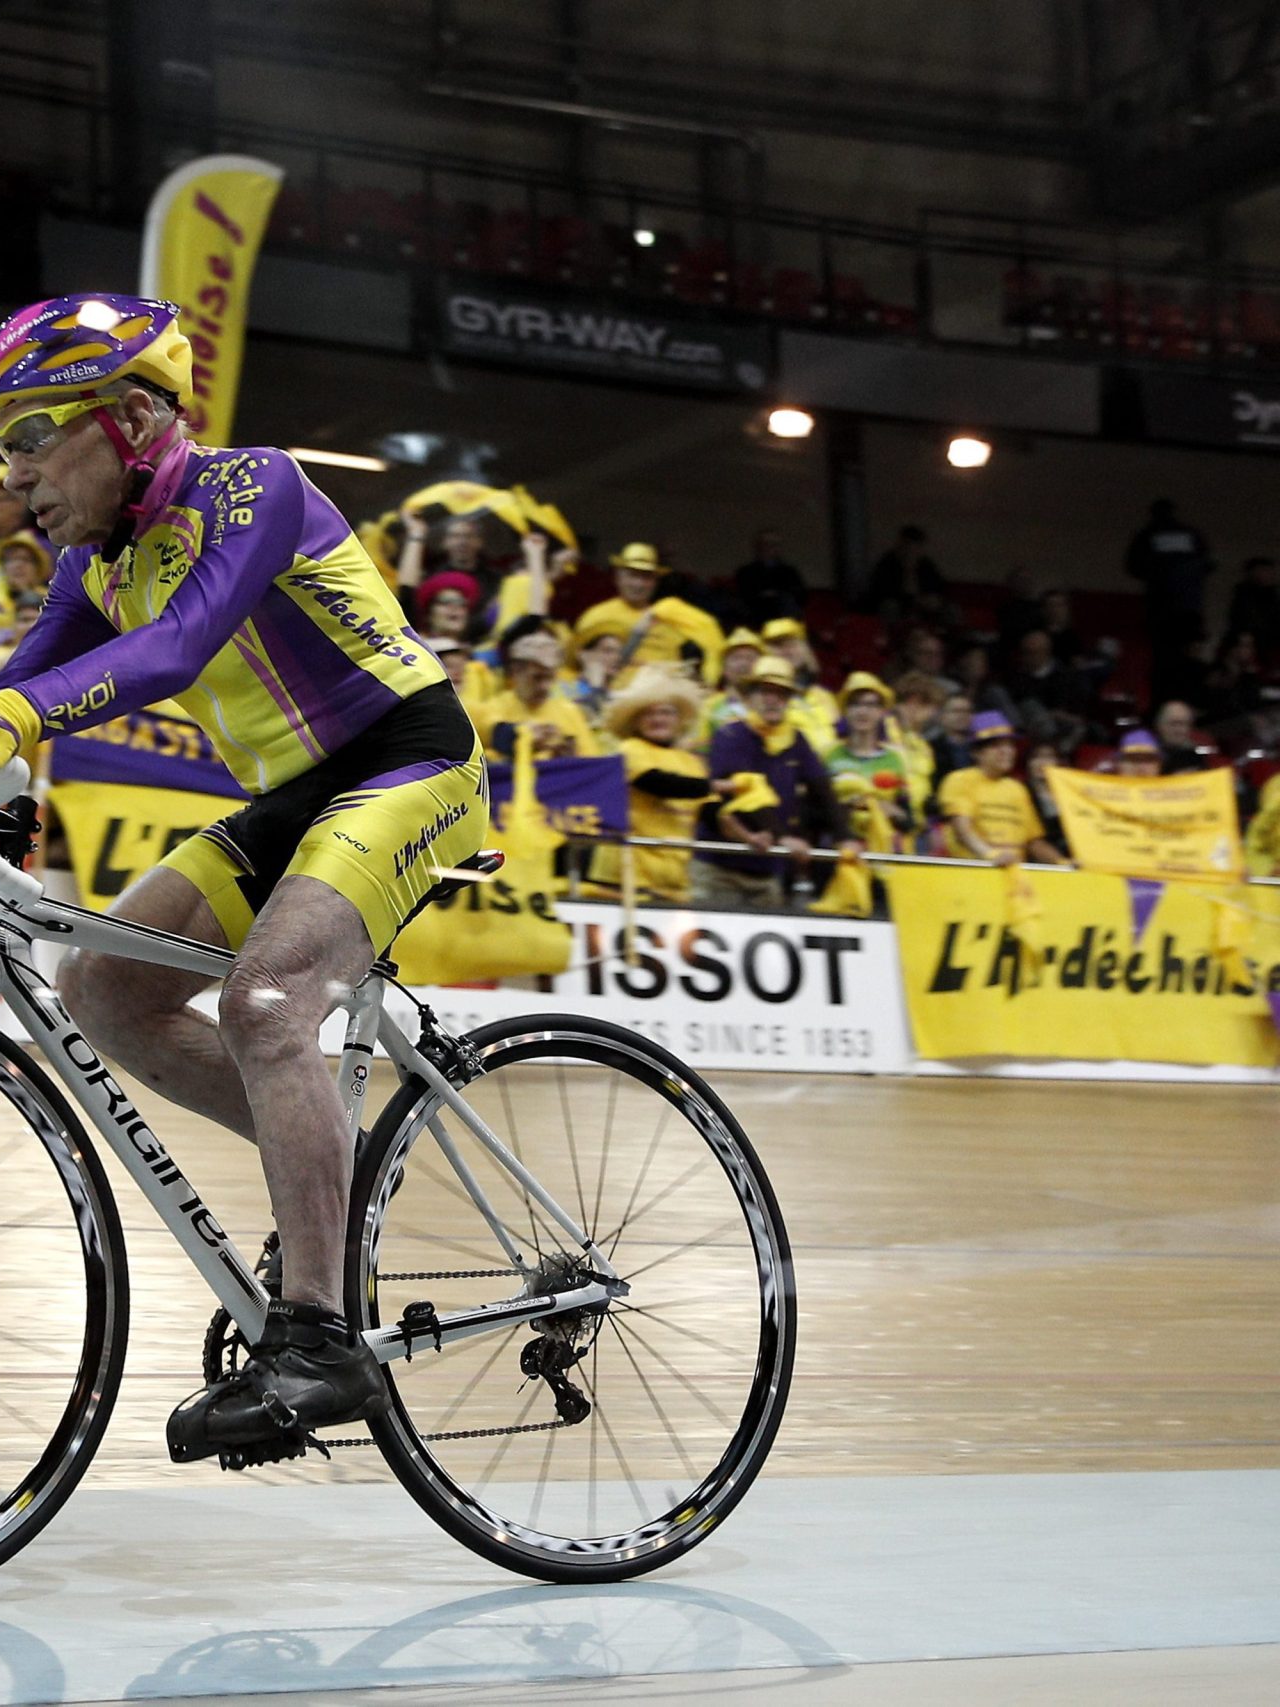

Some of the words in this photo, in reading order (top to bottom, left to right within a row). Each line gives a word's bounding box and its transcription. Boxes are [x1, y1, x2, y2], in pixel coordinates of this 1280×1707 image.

[539, 922, 862, 1006] ISSOT
[684, 1022, 788, 1058] SINCE
[802, 1027, 875, 1060] 1853
